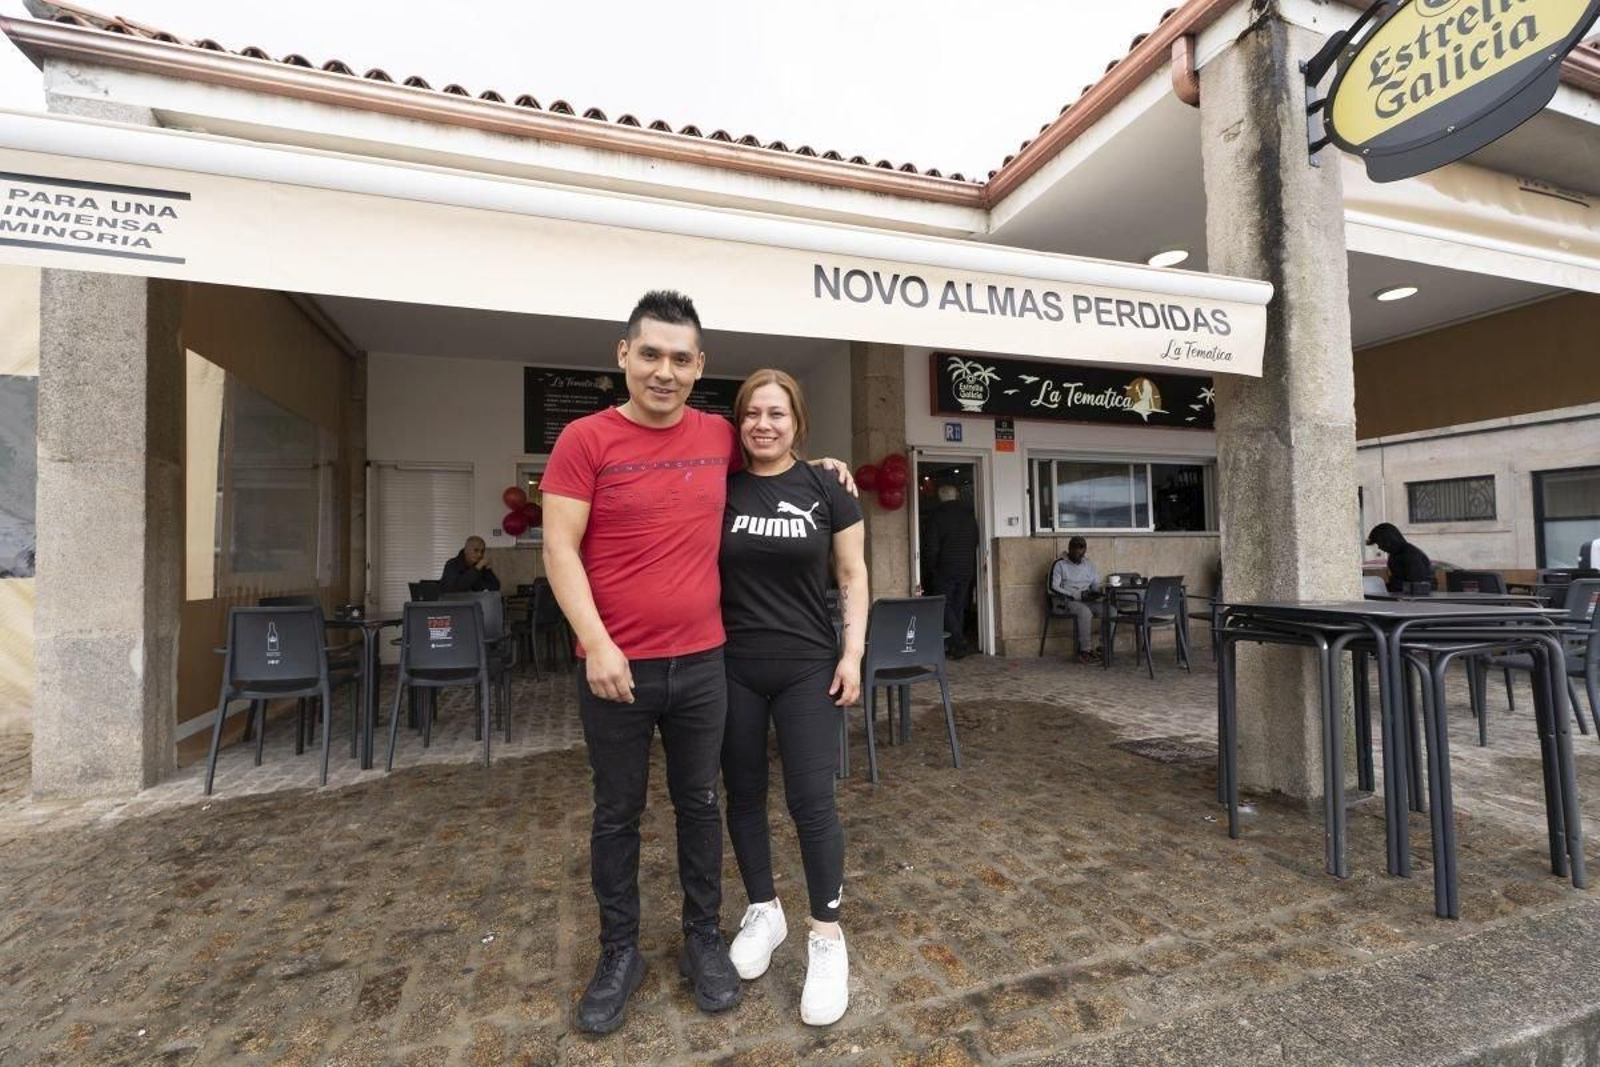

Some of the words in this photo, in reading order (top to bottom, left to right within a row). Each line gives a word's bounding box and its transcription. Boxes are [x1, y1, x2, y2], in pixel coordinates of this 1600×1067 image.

[1375, 14, 1541, 119] Galicia
[8, 188, 100, 211] PARA
[111, 200, 179, 219] UNA
[4, 205, 164, 234] INMENSA
[0, 220, 153, 249] MINORIA
[813, 264, 930, 309] NOVO
[938, 280, 1065, 322] ALMAS
[1073, 294, 1232, 336] PERDIDAS
[1160, 339, 1182, 360] La
[1184, 340, 1234, 362] Tematica
[1030, 380, 1061, 408] La
[1062, 382, 1134, 409] Tematica
[730, 515, 807, 538] PUMA
